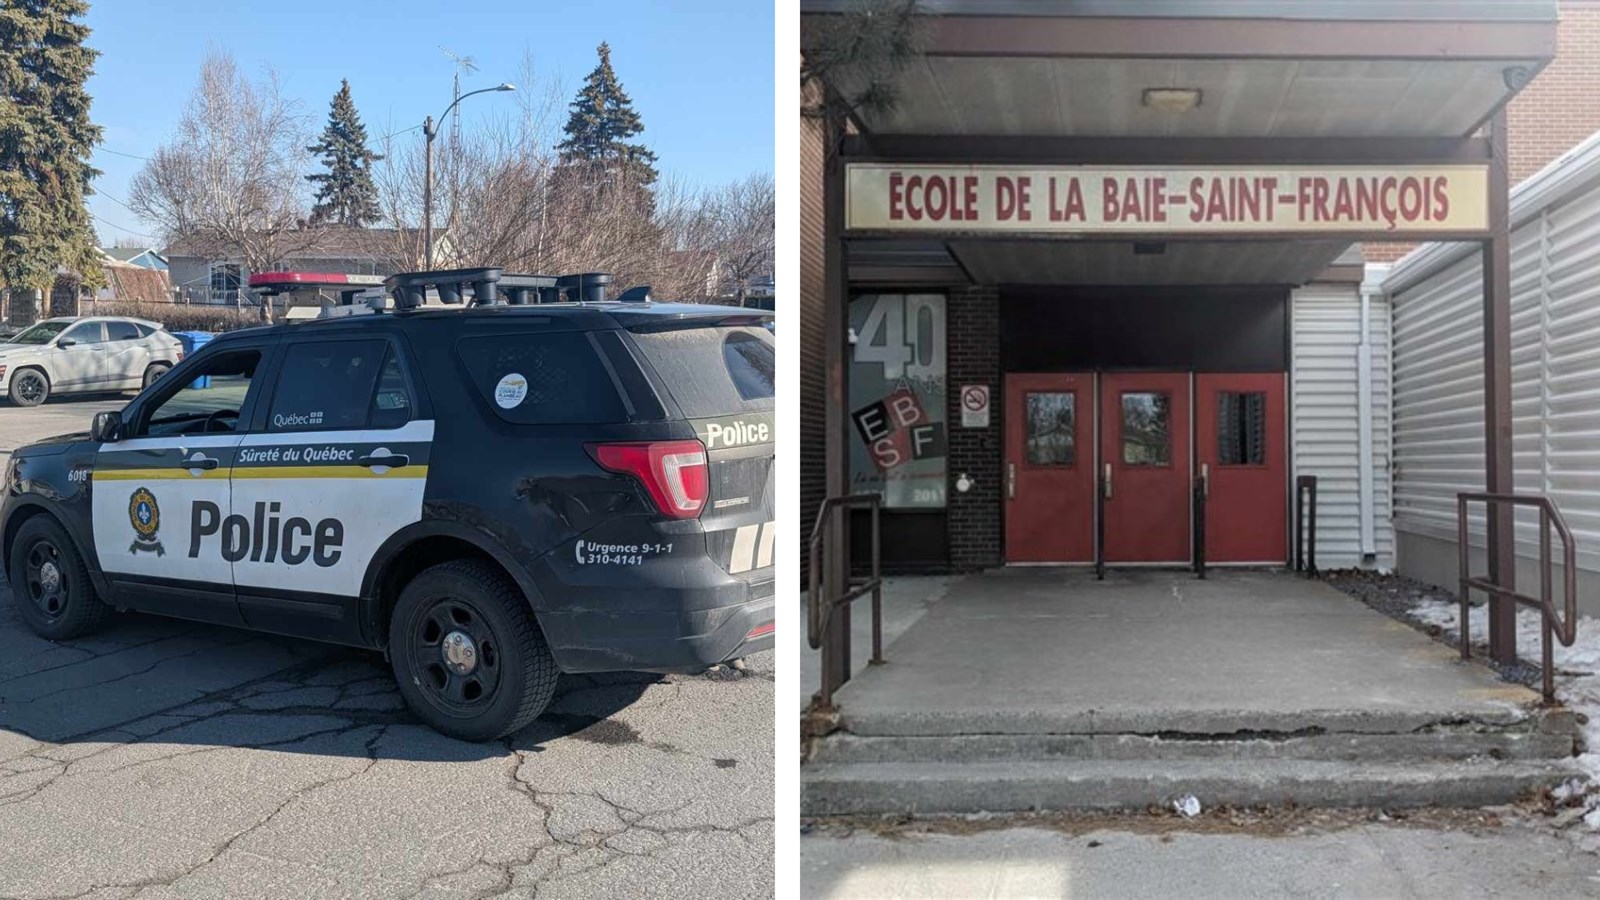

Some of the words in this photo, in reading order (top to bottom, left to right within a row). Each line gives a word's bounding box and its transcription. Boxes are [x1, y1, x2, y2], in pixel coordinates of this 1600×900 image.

[889, 172, 978, 221] ÉCOLE
[996, 176, 1032, 221] DE
[1049, 177, 1086, 222] LA
[1103, 176, 1449, 230] BAIE-SAINT-FRANÇOIS
[854, 294, 946, 379] 40
[273, 413, 309, 427] Québec
[705, 420, 769, 448] Police
[239, 448, 281, 462] Sûreté
[282, 448, 301, 461] du
[303, 446, 355, 462] Québec
[68, 470, 87, 481] 6018
[188, 500, 344, 567] Police
[587, 542, 639, 554] Urgence
[642, 543, 673, 553] 9-1-1
[587, 554, 643, 565] 310-4141
